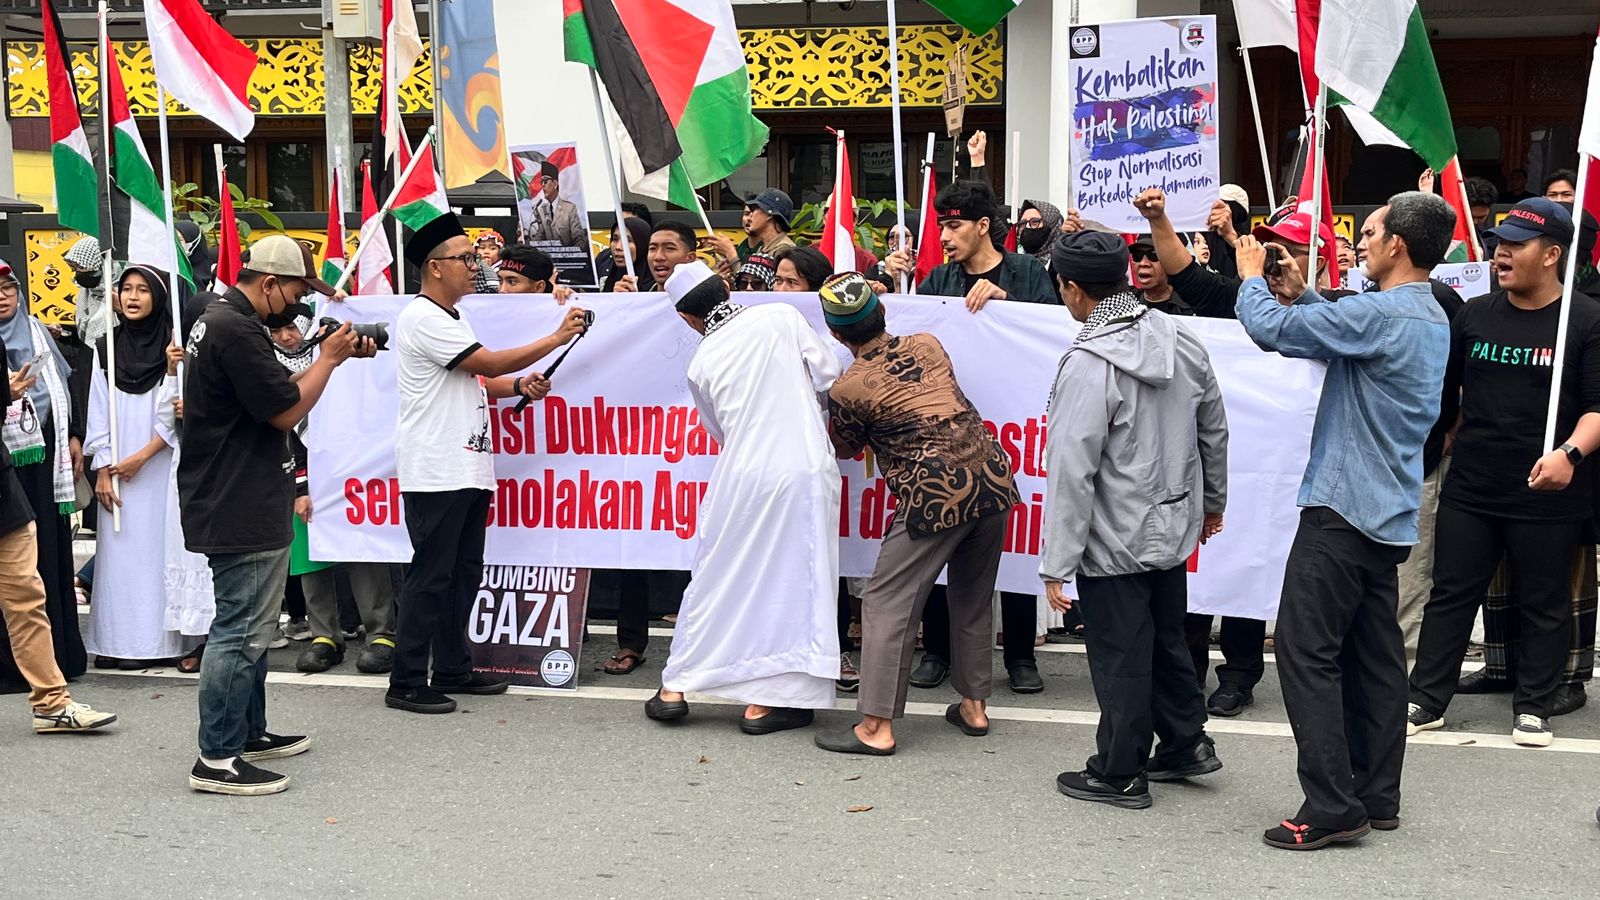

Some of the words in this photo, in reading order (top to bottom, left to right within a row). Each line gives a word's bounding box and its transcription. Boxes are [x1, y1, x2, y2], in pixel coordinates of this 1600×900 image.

[1075, 47, 1205, 103] Kembalikan
[1080, 108, 1118, 149] Hak
[1079, 163, 1112, 187] Stop
[1119, 150, 1202, 180] Normalisasi
[1078, 182, 1134, 211] Berkedok
[1471, 341, 1553, 366] PALESTIN
[468, 590, 570, 648] GAZA
[547, 662, 569, 671] BPP
